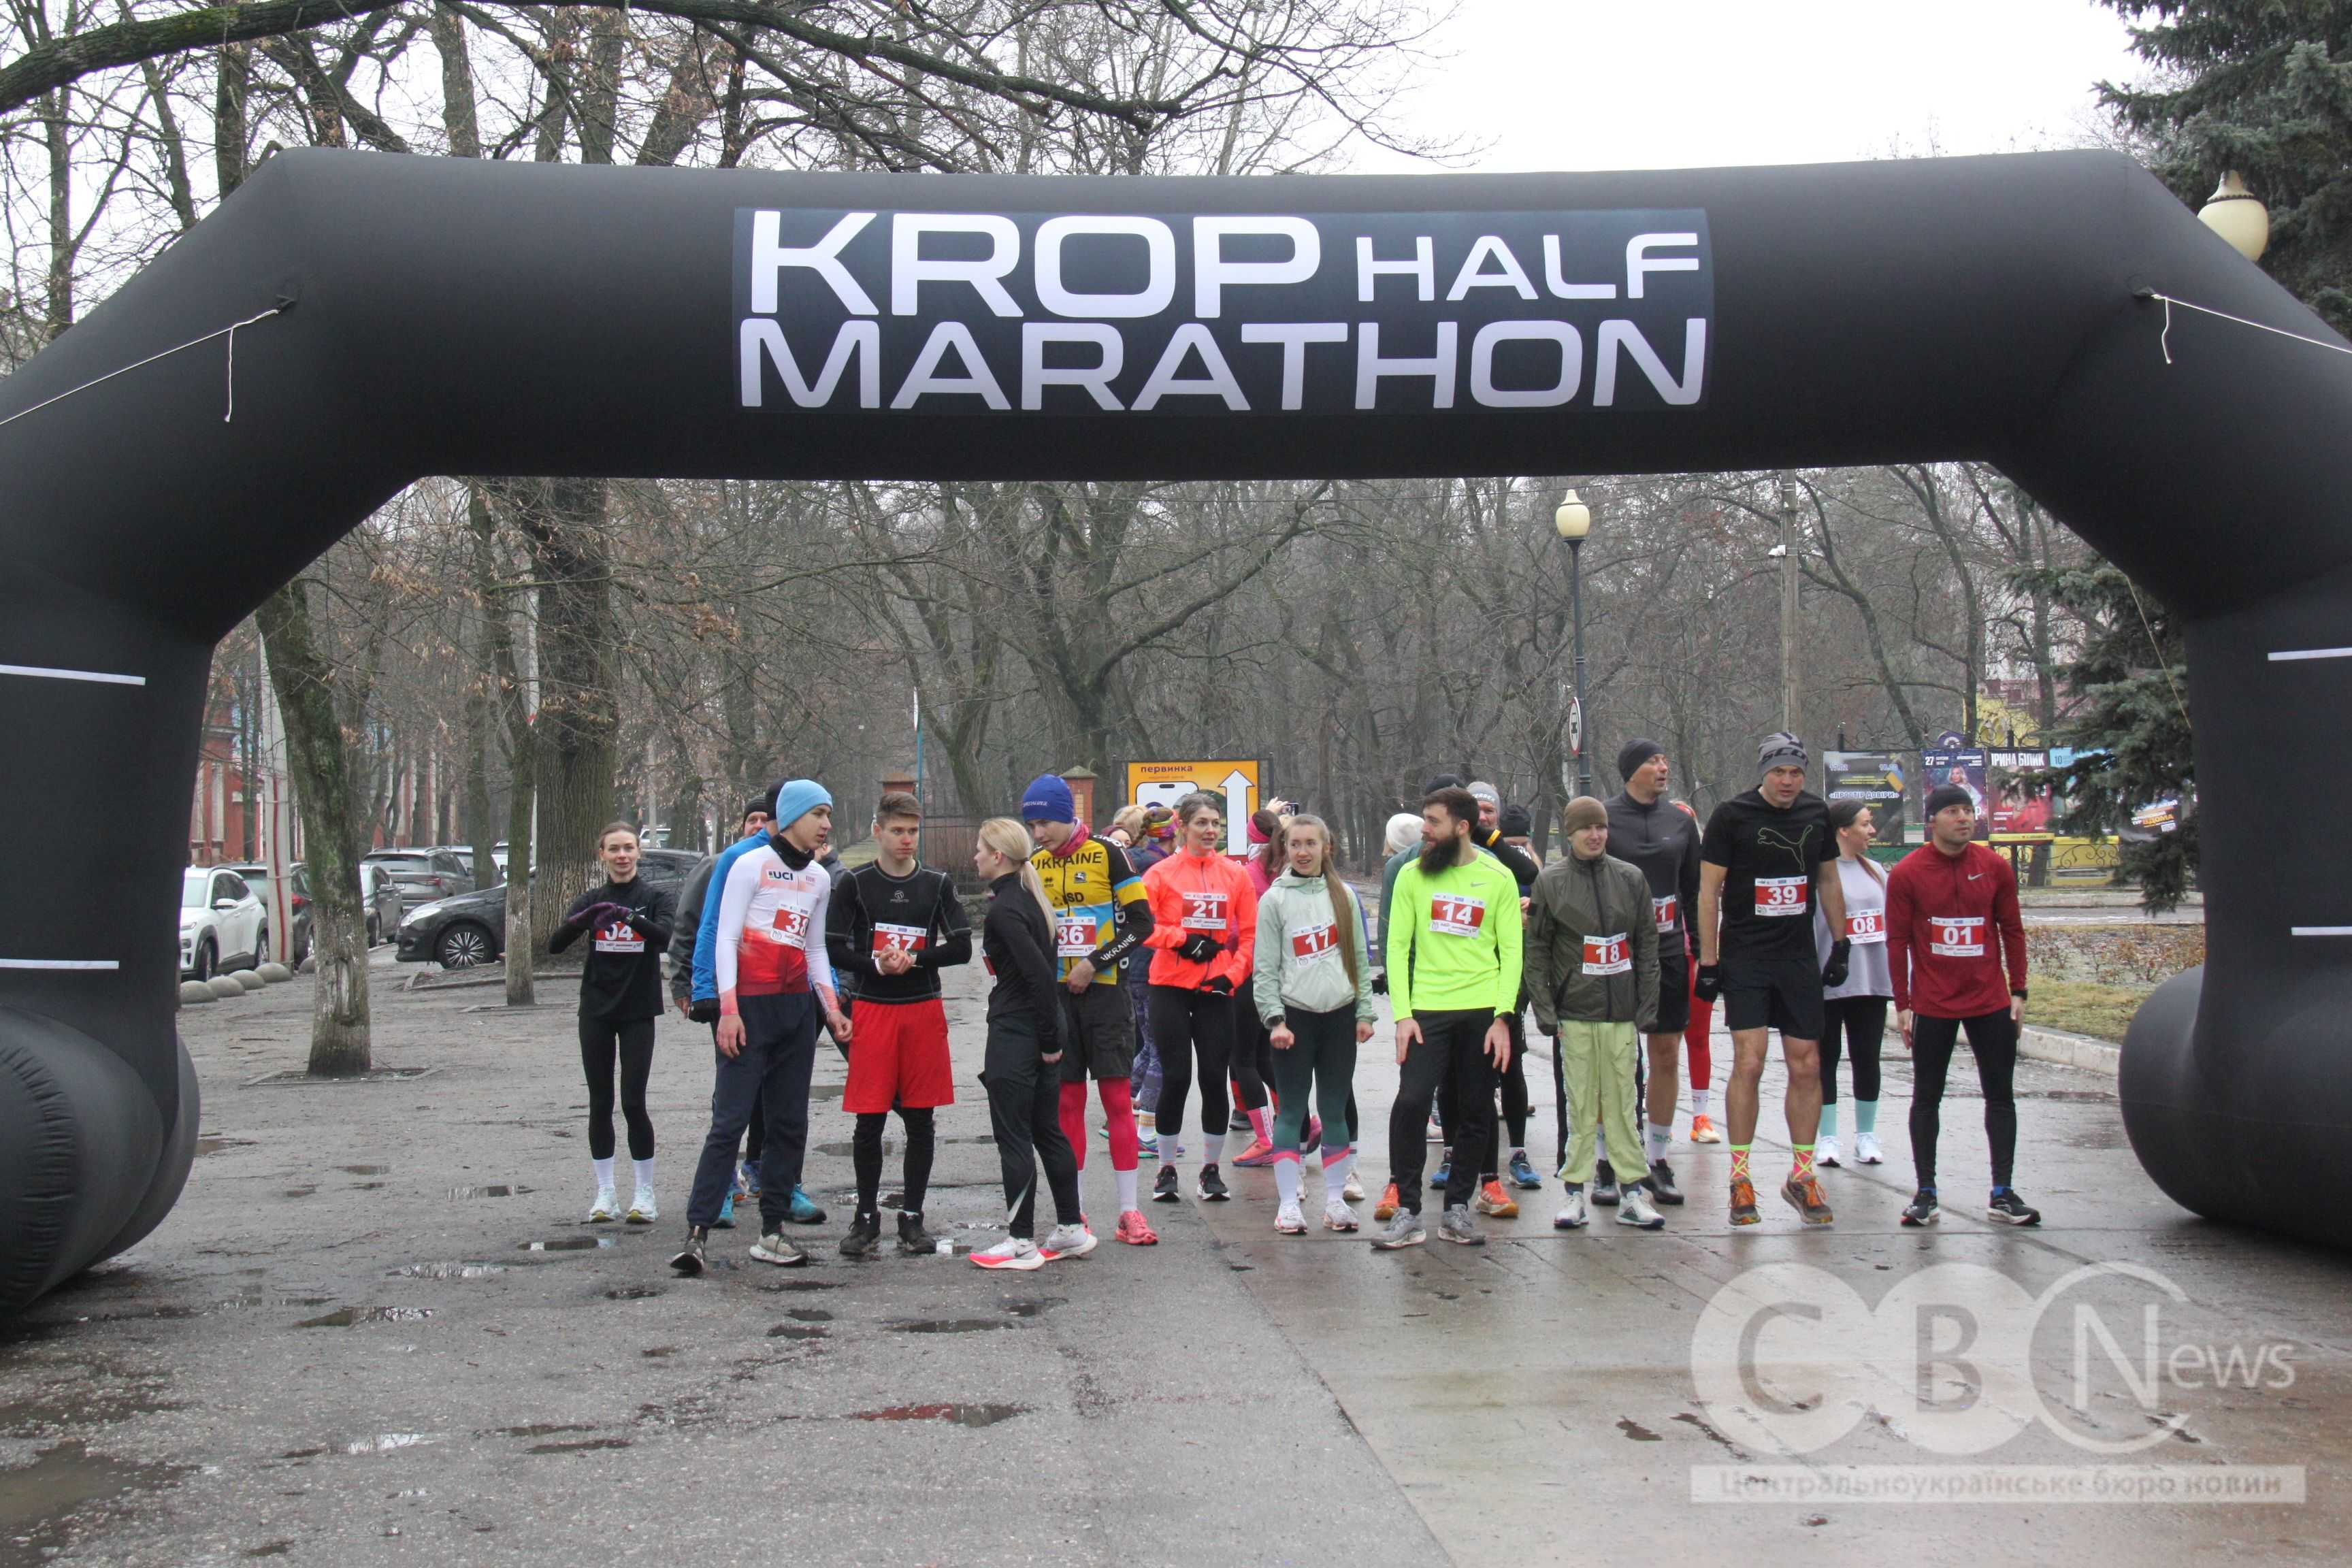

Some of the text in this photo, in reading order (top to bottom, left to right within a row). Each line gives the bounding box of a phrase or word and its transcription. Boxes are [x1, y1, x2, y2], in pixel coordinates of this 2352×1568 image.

[751, 210, 1699, 318] KROP HALF
[740, 316, 1707, 410] MARATHON
[1925, 756, 1934, 766] 27
[1991, 752, 2016, 767] ІРИНА
[2017, 752, 2045, 767] БІЛИК
[1141, 765, 1193, 774] первинка
[1030, 851, 1103, 870] UKRAINE
[773, 871, 794, 881] UCI
[1767, 886, 1797, 904] 39
[1192, 900, 1218, 918] 21
[1442, 902, 1472, 924] 14
[785, 913, 808, 937] 38
[1852, 917, 1876, 934] 08
[886, 933, 917, 951] 37
[1058, 925, 1084, 945] 36
[1305, 928, 1329, 952] 17
[1943, 926, 1972, 945] 01
[1100, 933, 1137, 961] UKRAINE
[1595, 943, 1620, 964] 18
